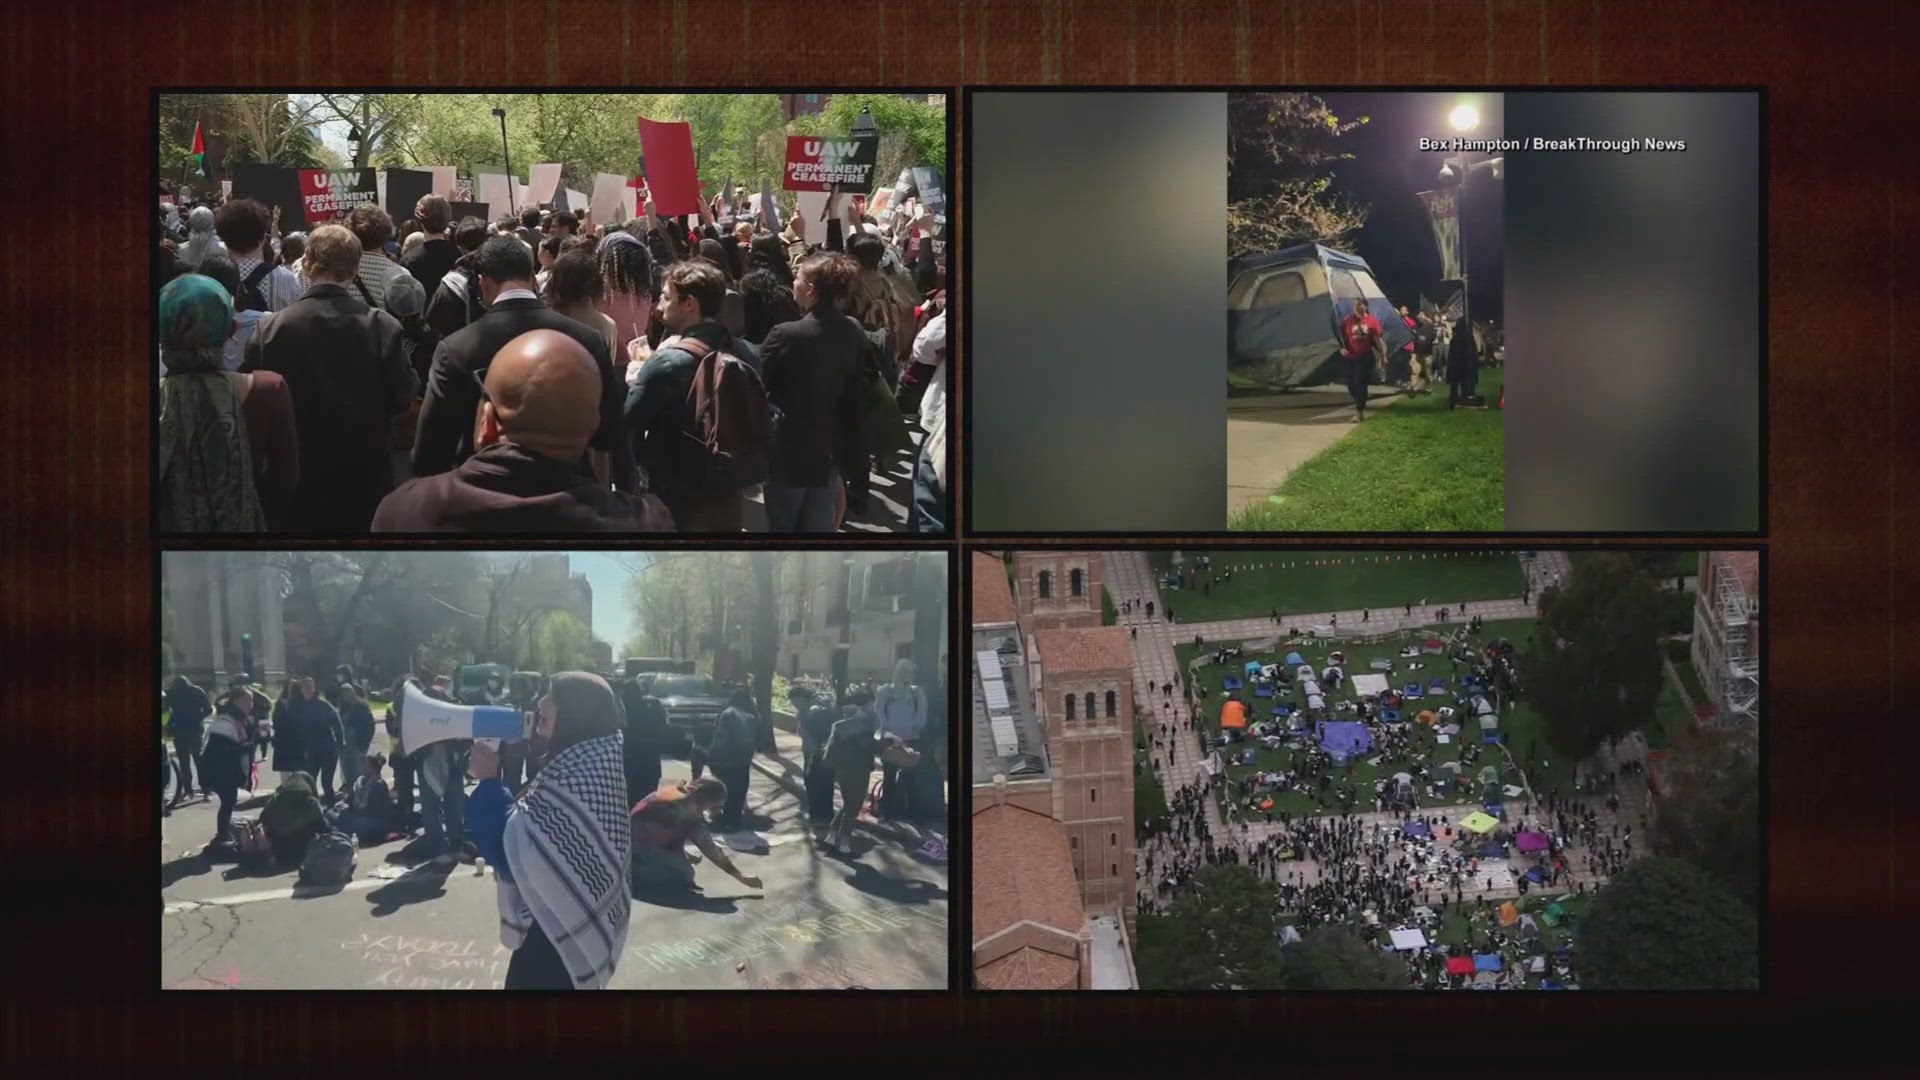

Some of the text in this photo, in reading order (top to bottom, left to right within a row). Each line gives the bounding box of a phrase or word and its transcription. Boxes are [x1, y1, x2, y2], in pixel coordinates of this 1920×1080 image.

[804, 141, 860, 157] UAW
[788, 162, 872, 174] PERMANENT
[313, 172, 361, 188] UAW
[791, 171, 865, 184] CEASEFIRE
[304, 191, 375, 205] PERMANENT
